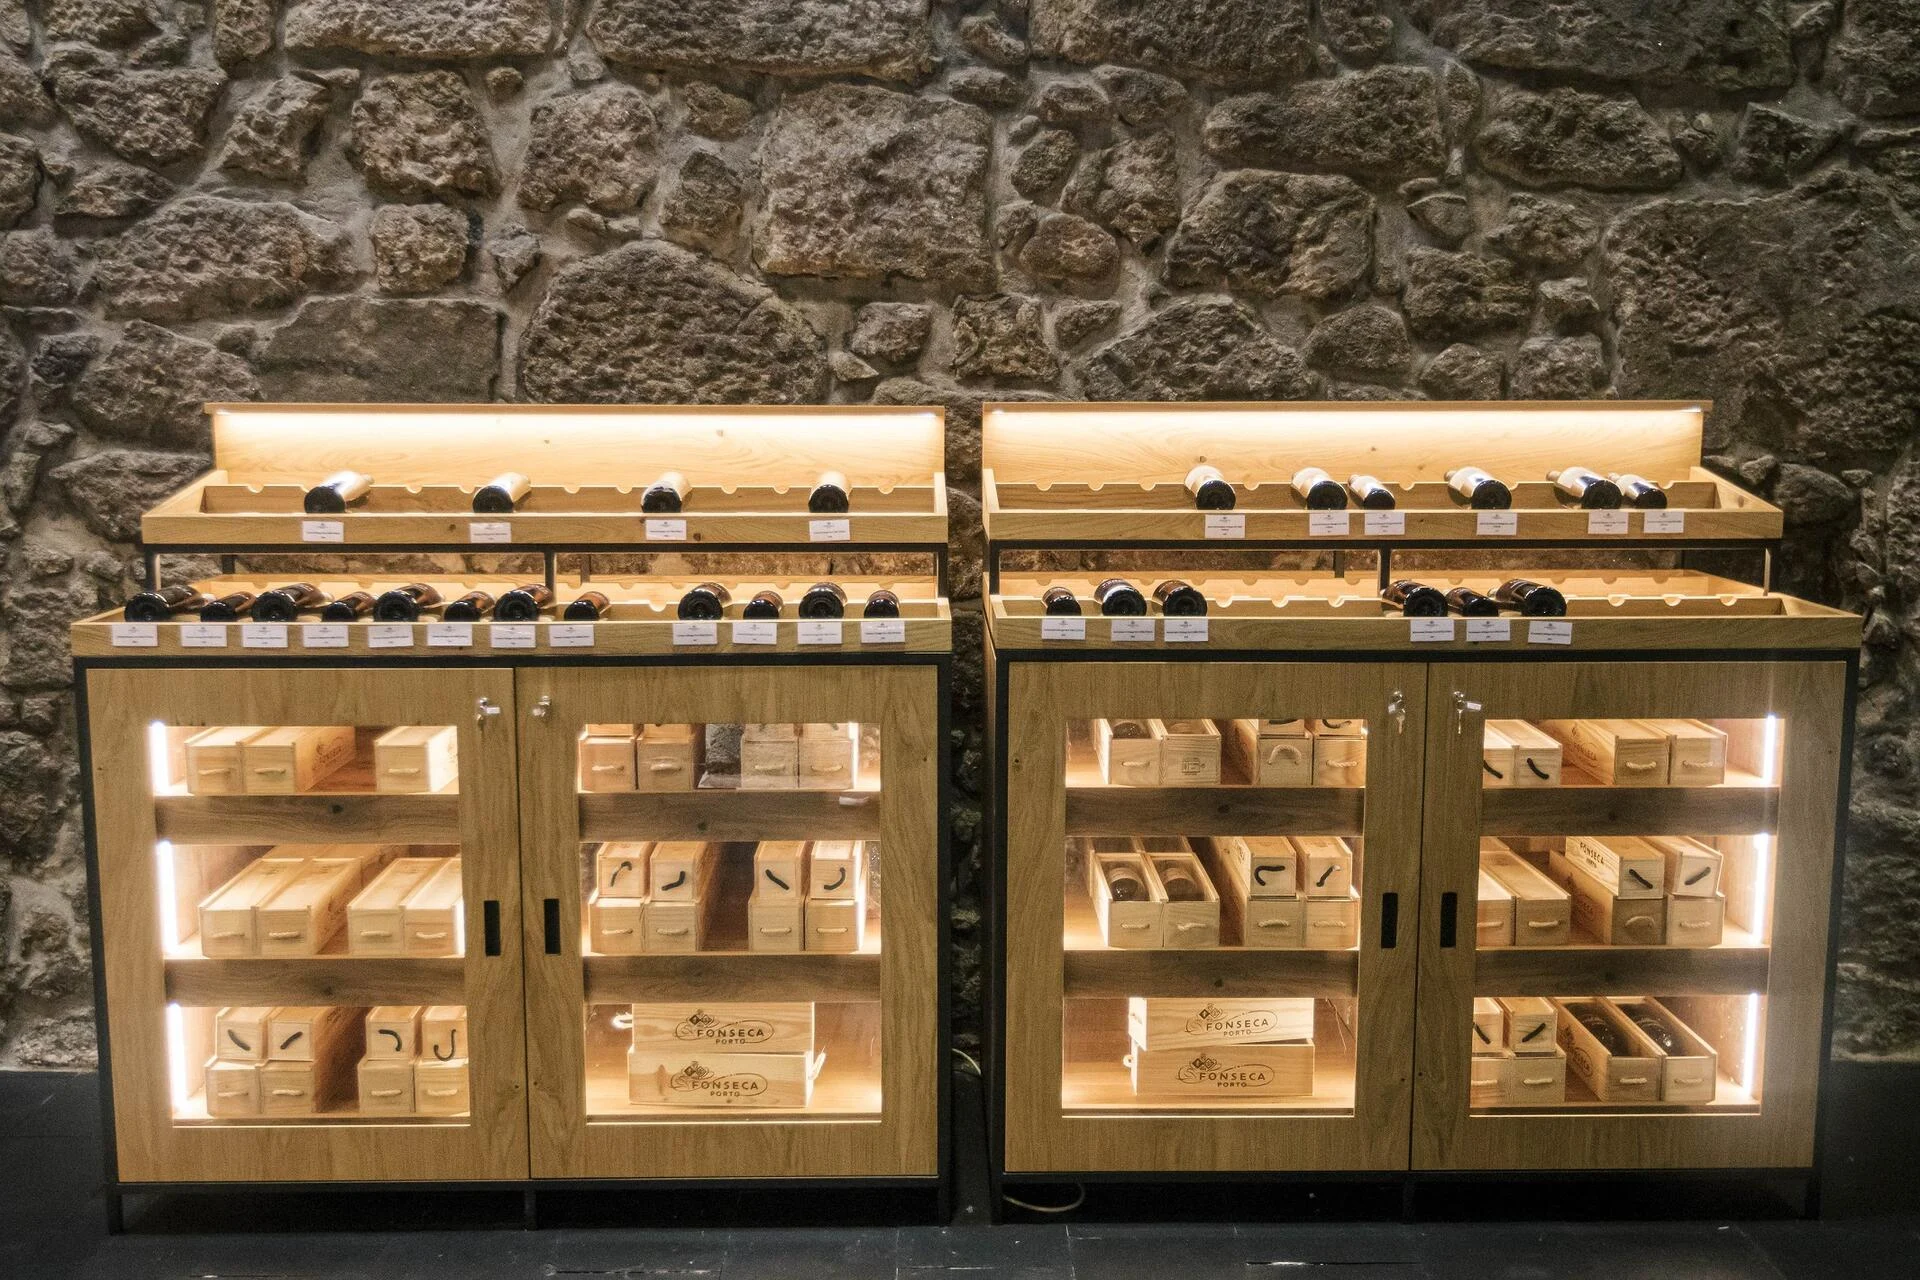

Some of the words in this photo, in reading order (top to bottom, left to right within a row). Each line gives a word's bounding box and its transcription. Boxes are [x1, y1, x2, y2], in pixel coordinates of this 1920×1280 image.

[1206, 1018, 1269, 1031] FONSECA
[697, 1028, 765, 1038] FONSECA
[1223, 1029, 1252, 1037] PORTO
[1199, 1072, 1266, 1081] FONSECA
[691, 1081, 759, 1090] FONSECA
